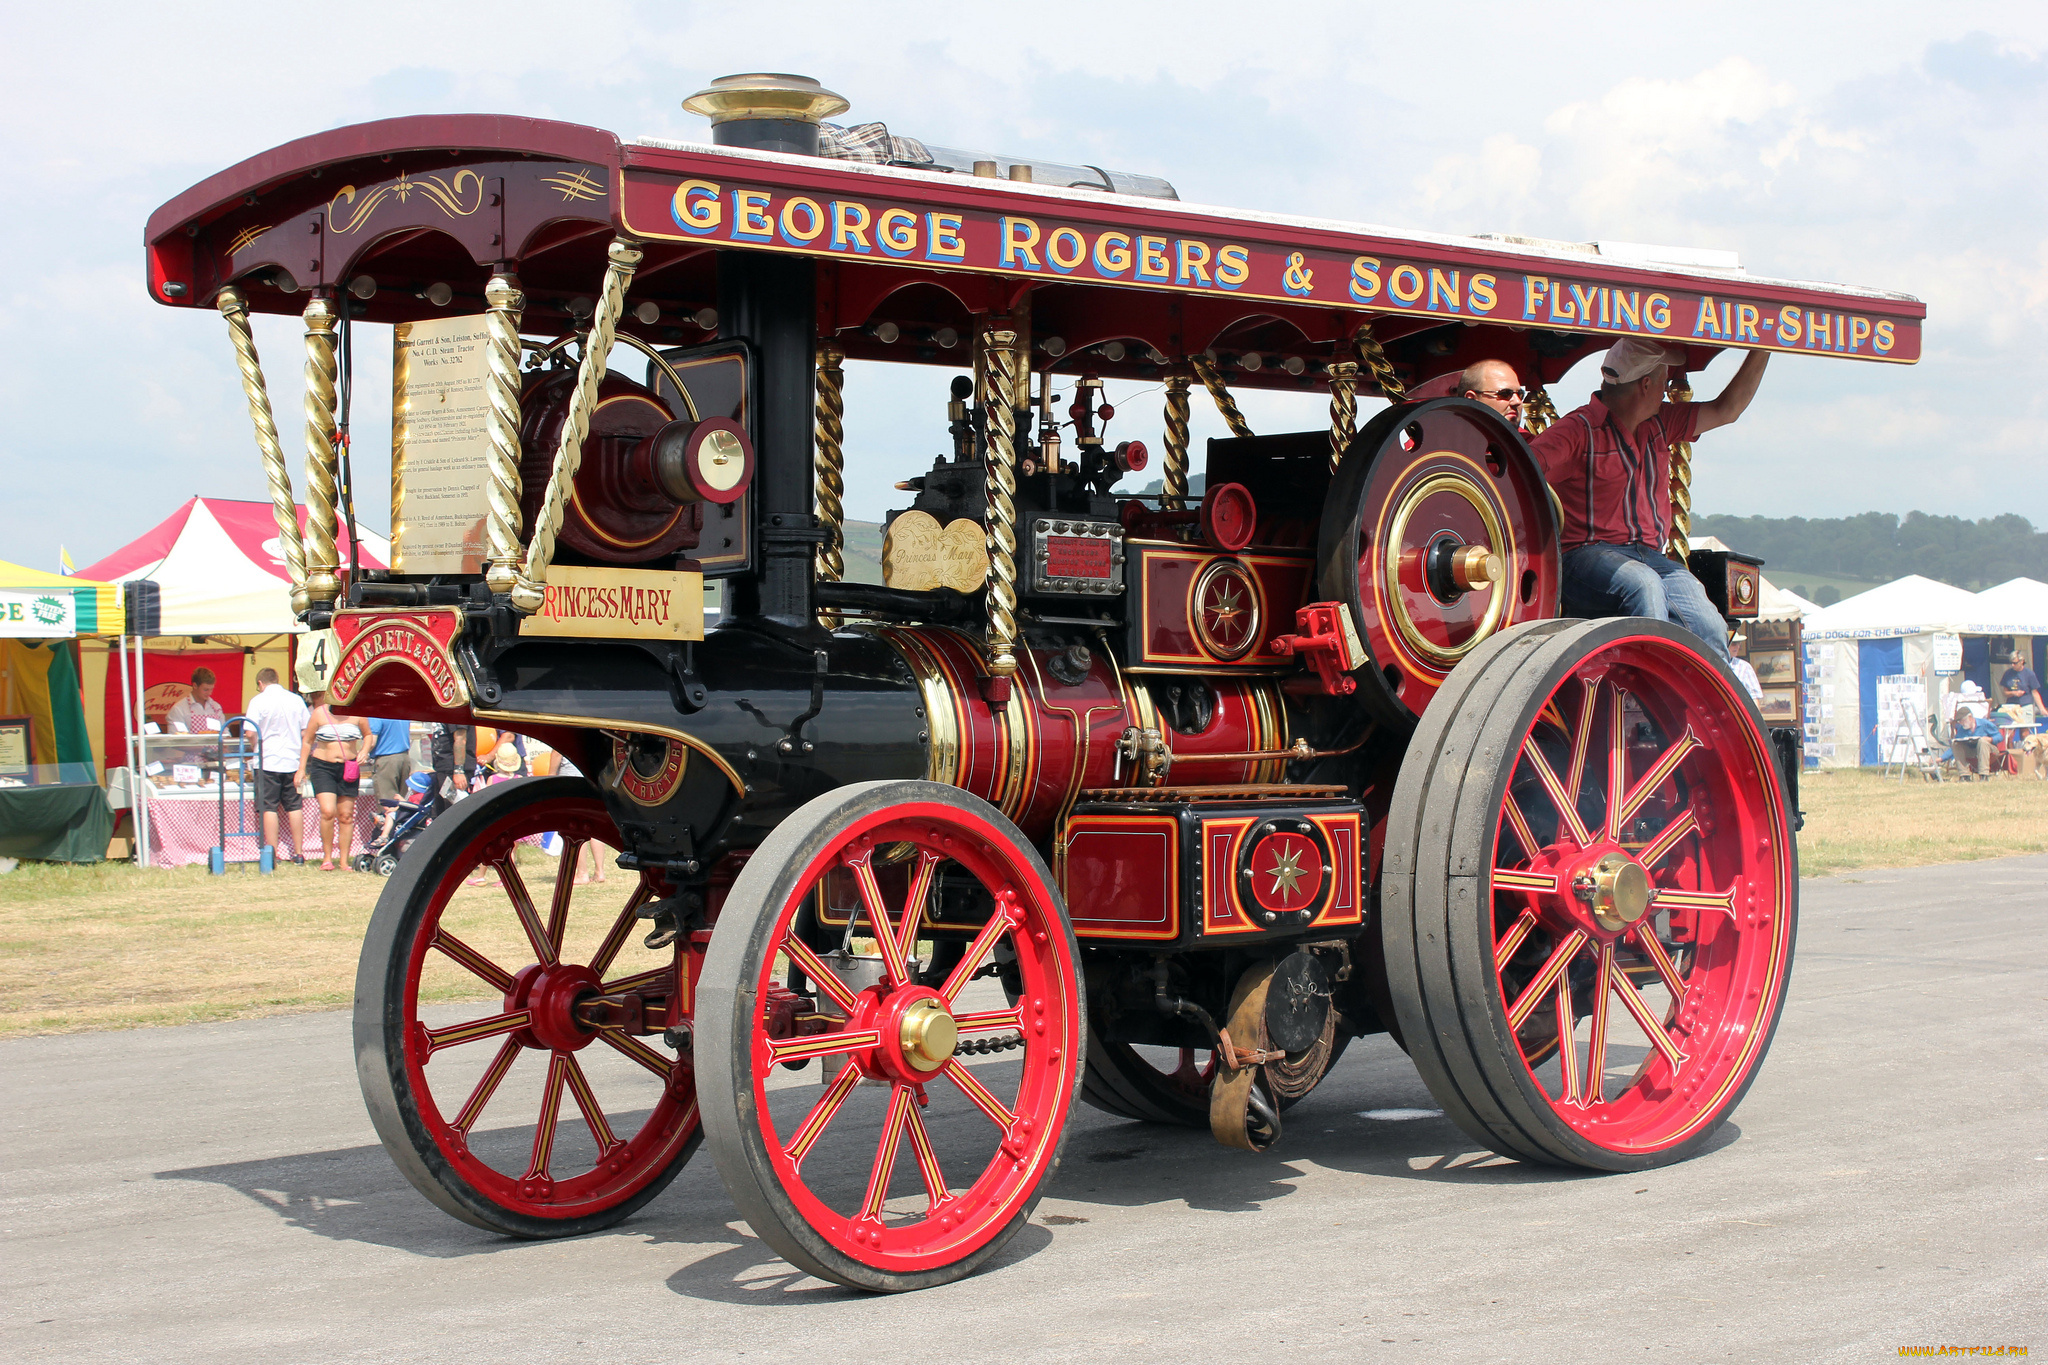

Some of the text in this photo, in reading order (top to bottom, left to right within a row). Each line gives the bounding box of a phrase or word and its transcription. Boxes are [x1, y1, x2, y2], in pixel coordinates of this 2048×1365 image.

[670, 179, 1895, 355] GEORGE ROGERS & SONS FLYING AIR-SHIPS
[896, 547, 974, 564] Princess Mary
[544, 586, 619, 622] RINCESS
[1825, 631, 1849, 639] DOGS
[1894, 626, 1920, 635] BLIND
[312, 639, 327, 680] 4
[343, 630, 416, 682] GARRETT
[422, 646, 455, 700] SONS
[162, 685, 184, 698] The
[632, 748, 681, 798] TRACTOR
